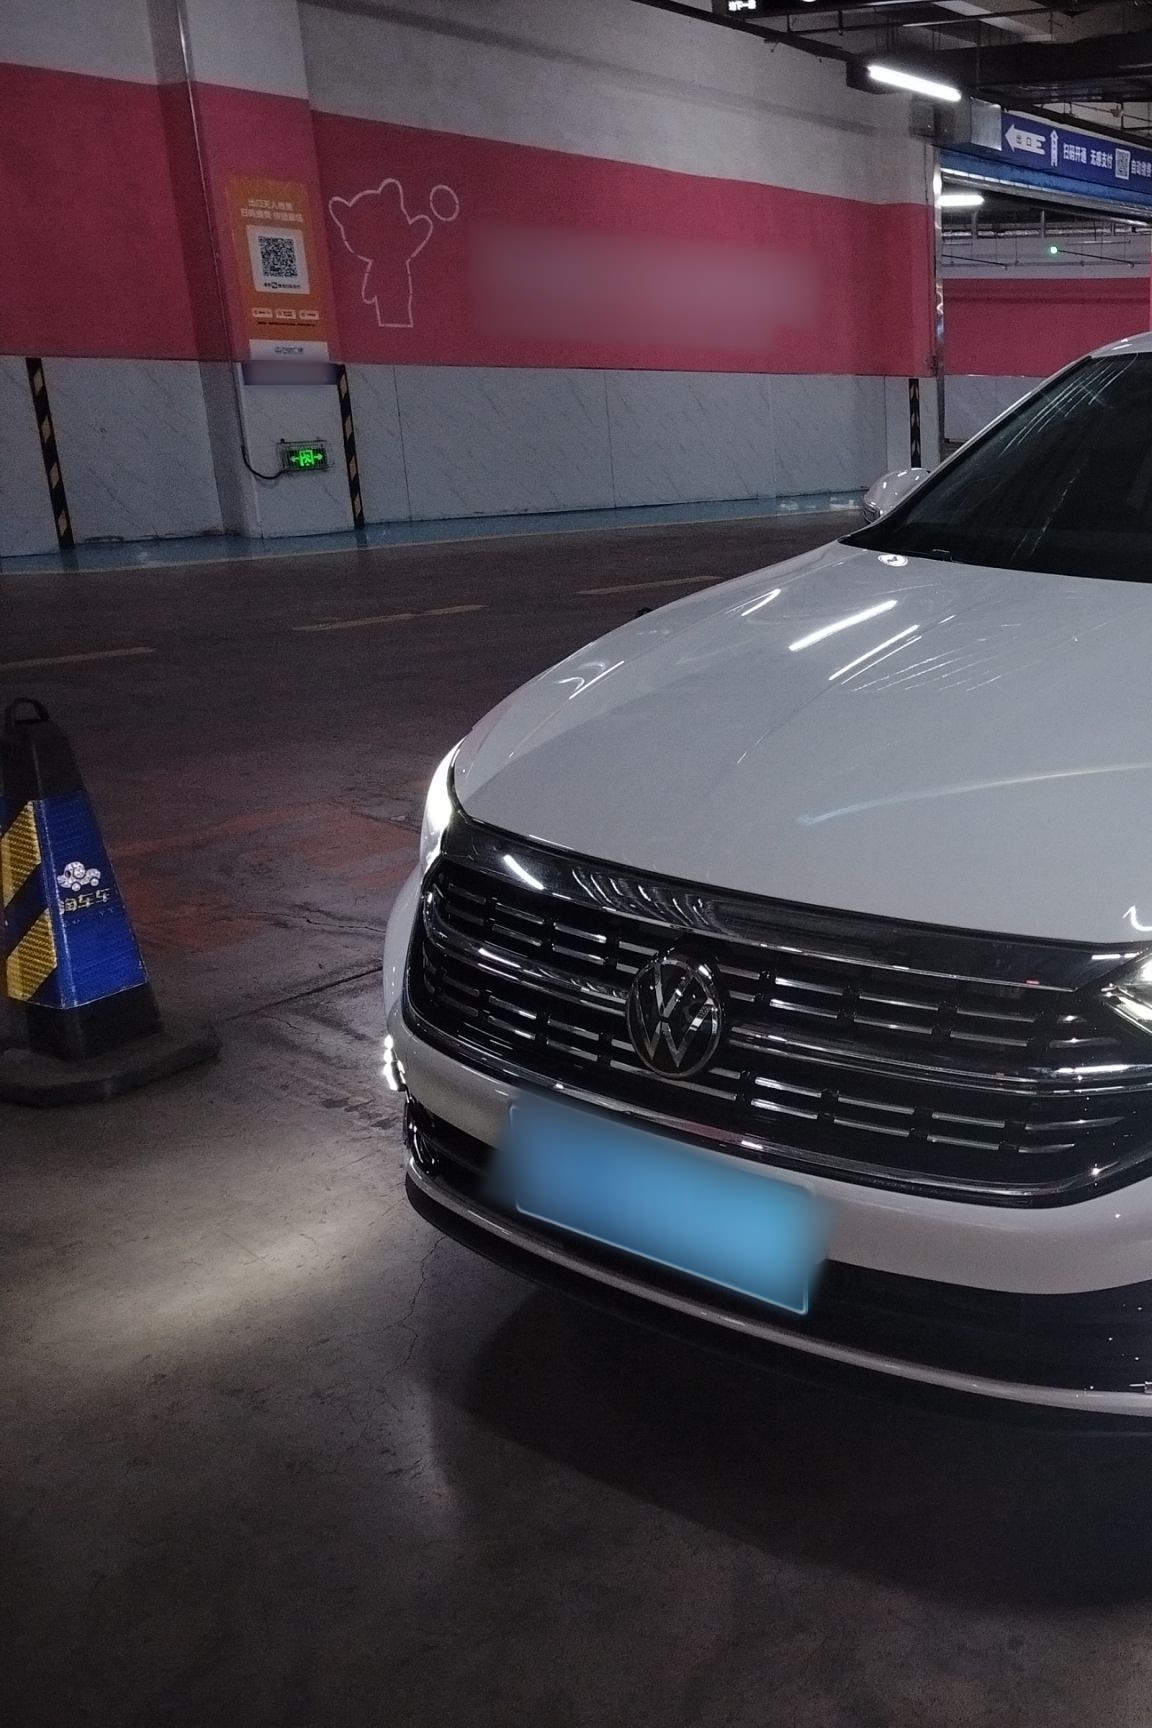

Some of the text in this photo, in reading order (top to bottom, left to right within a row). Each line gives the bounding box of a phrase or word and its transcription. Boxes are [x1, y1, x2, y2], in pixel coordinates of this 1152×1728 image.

[1015, 134, 1032, 147] 出口
[1090, 150, 1113, 169] 无感支付
